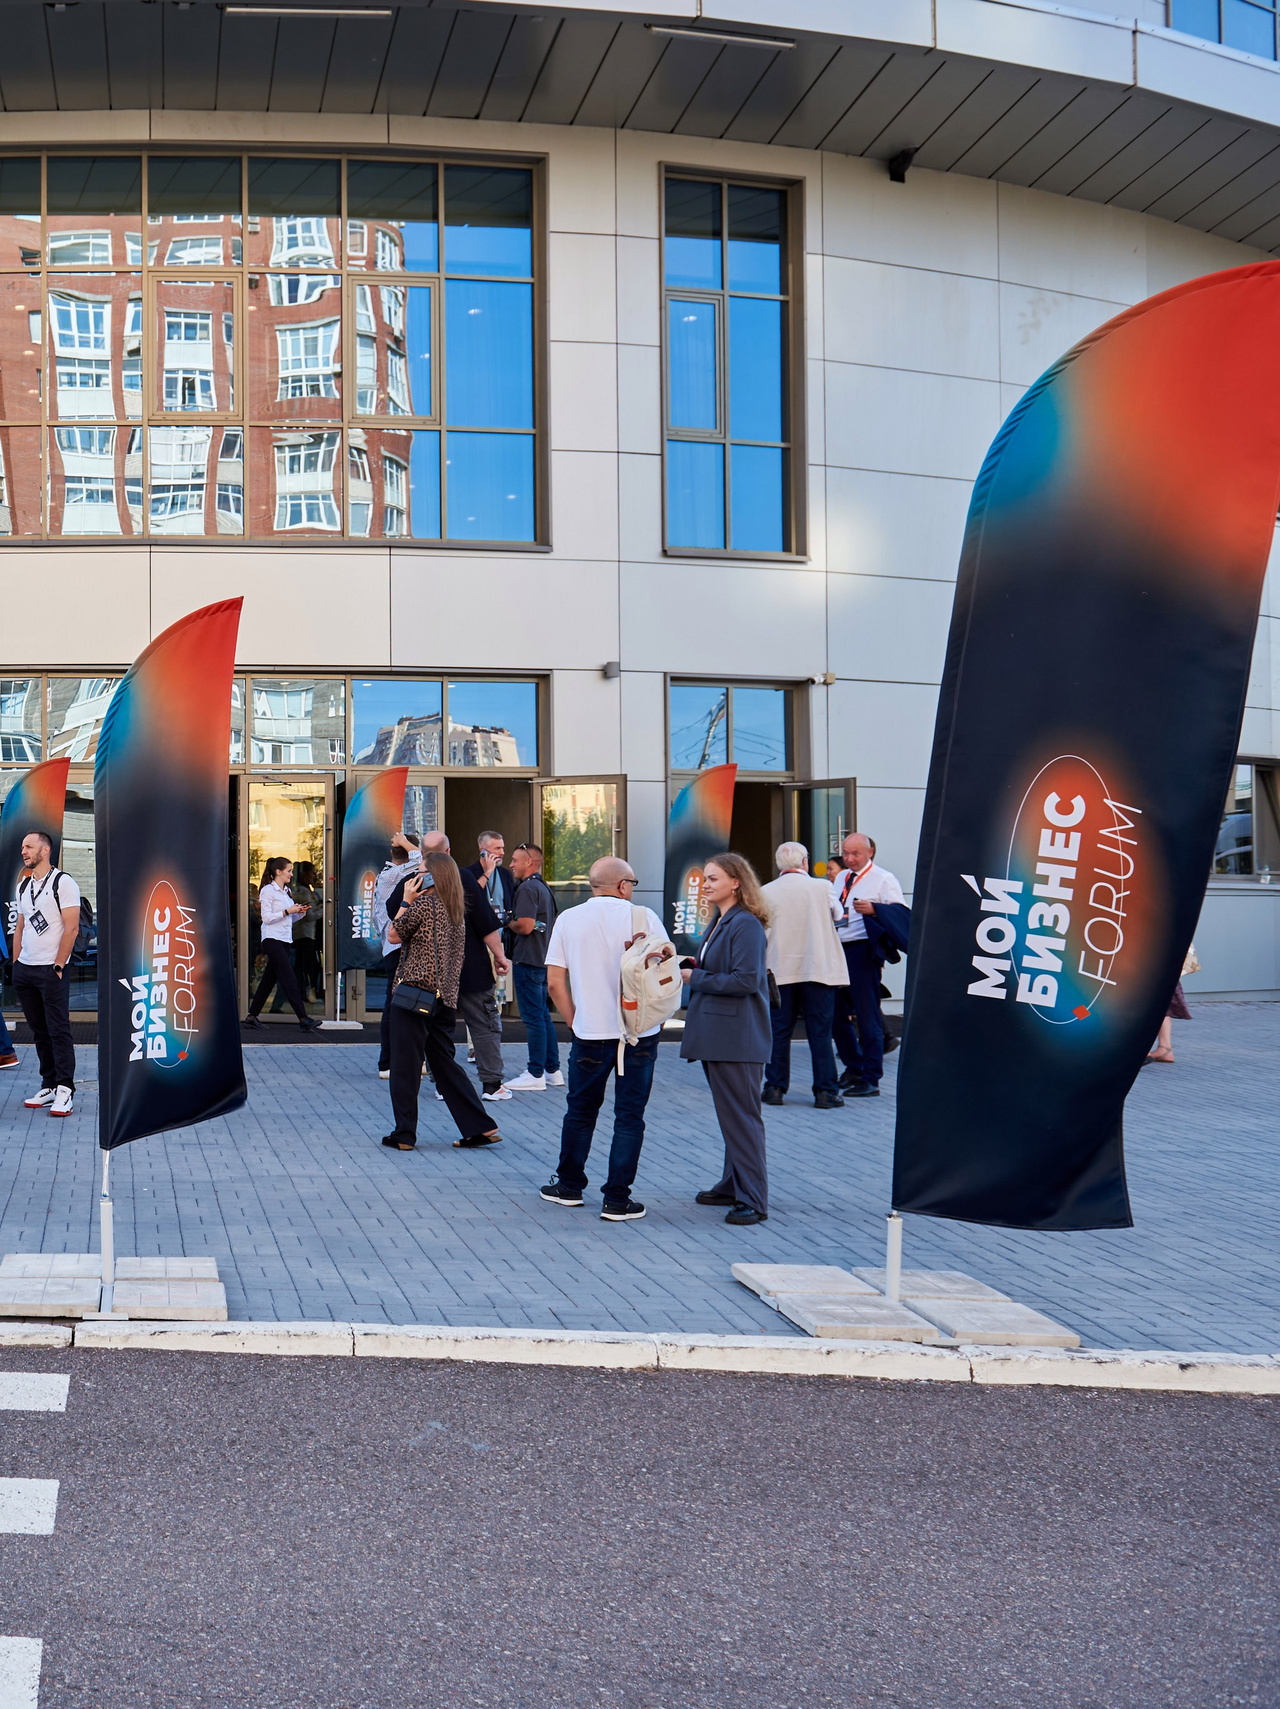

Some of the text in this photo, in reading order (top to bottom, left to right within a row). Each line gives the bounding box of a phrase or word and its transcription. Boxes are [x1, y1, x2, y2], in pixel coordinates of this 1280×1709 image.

[348, 905, 362, 939] МОЙ
[362, 880, 373, 938] БИЗНЕС
[672, 901, 686, 935] МОЙ
[685, 876, 700, 934] БИЗНЕС
[699, 893, 709, 925] FOR
[1016, 791, 1086, 1008] БИЗНЕС
[1078, 798, 1142, 985] FORUM
[174, 905, 199, 1033] FORUM
[960, 874, 1023, 999] МОЙ
[118, 974, 149, 1061] МОЙ
[146, 906, 171, 1059] БИЗНЕС
